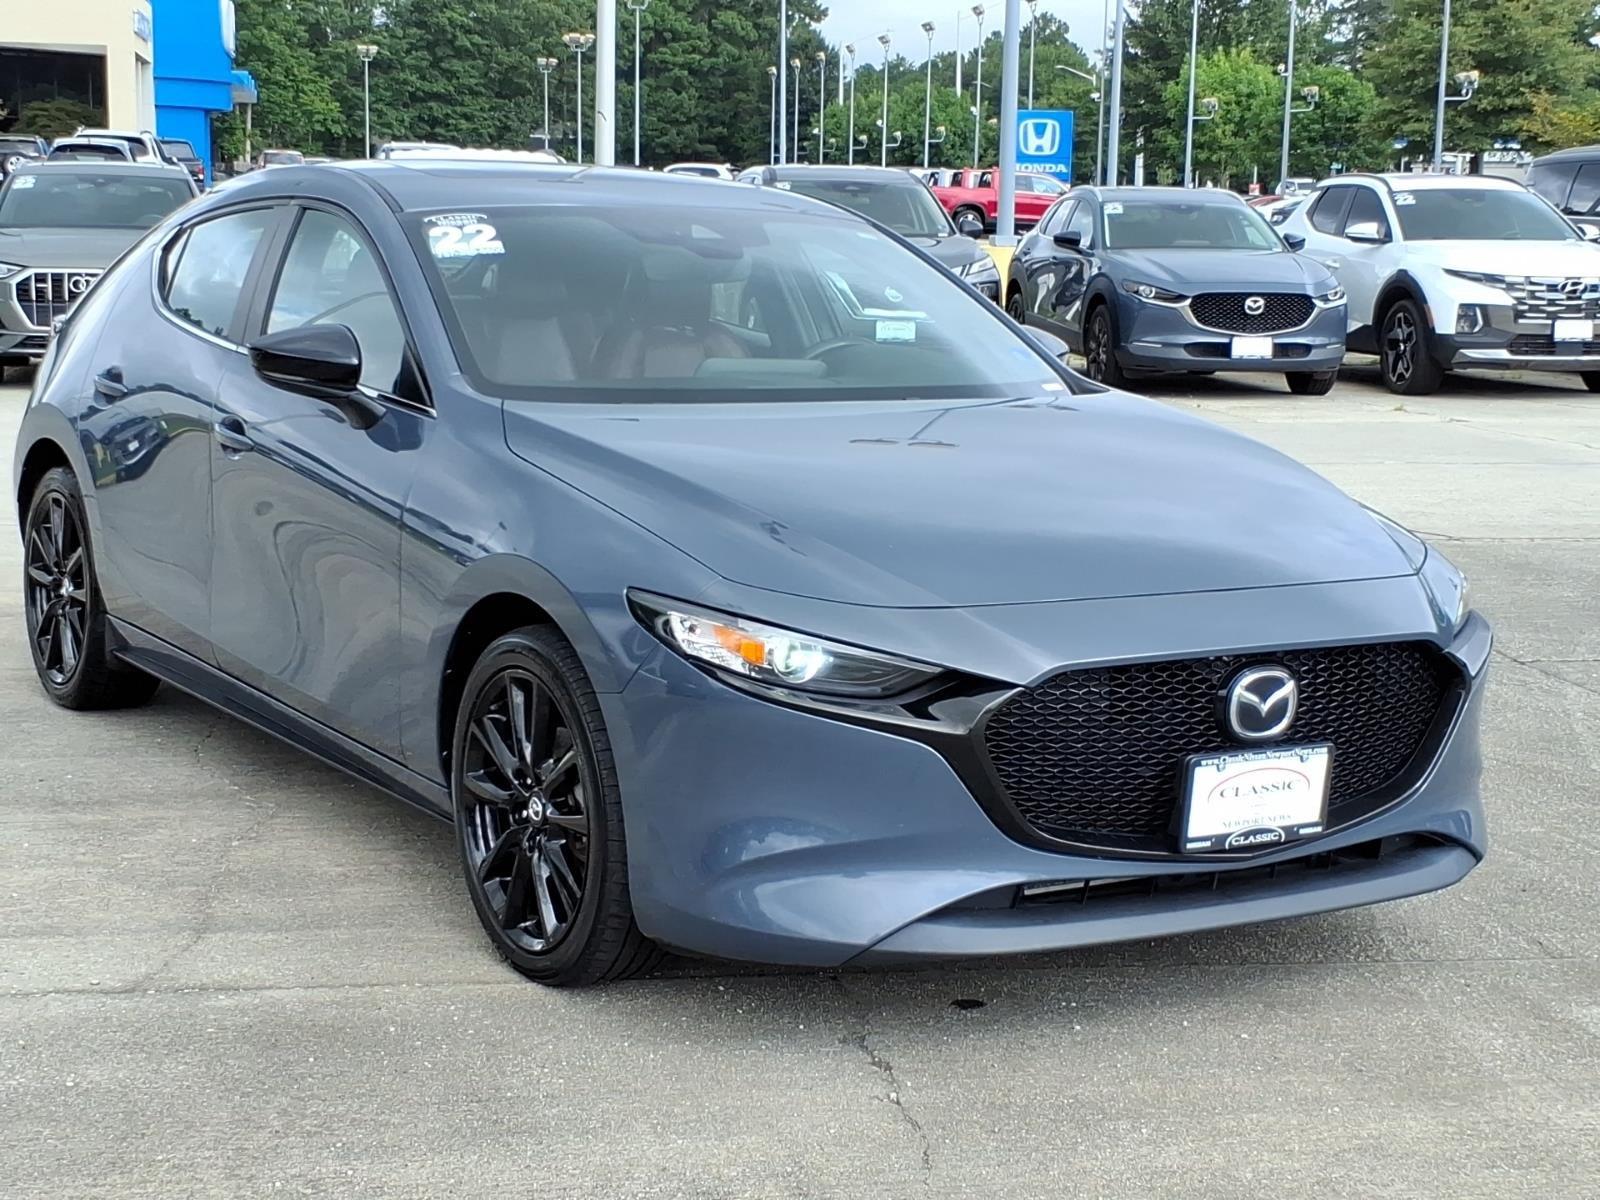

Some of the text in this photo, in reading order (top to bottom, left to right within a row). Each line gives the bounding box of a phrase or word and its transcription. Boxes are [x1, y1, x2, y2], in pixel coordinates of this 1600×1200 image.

[429, 223, 503, 252] 22
[1219, 780, 1295, 798] CLASSIC
[1231, 832, 1280, 845] CLASSIC
